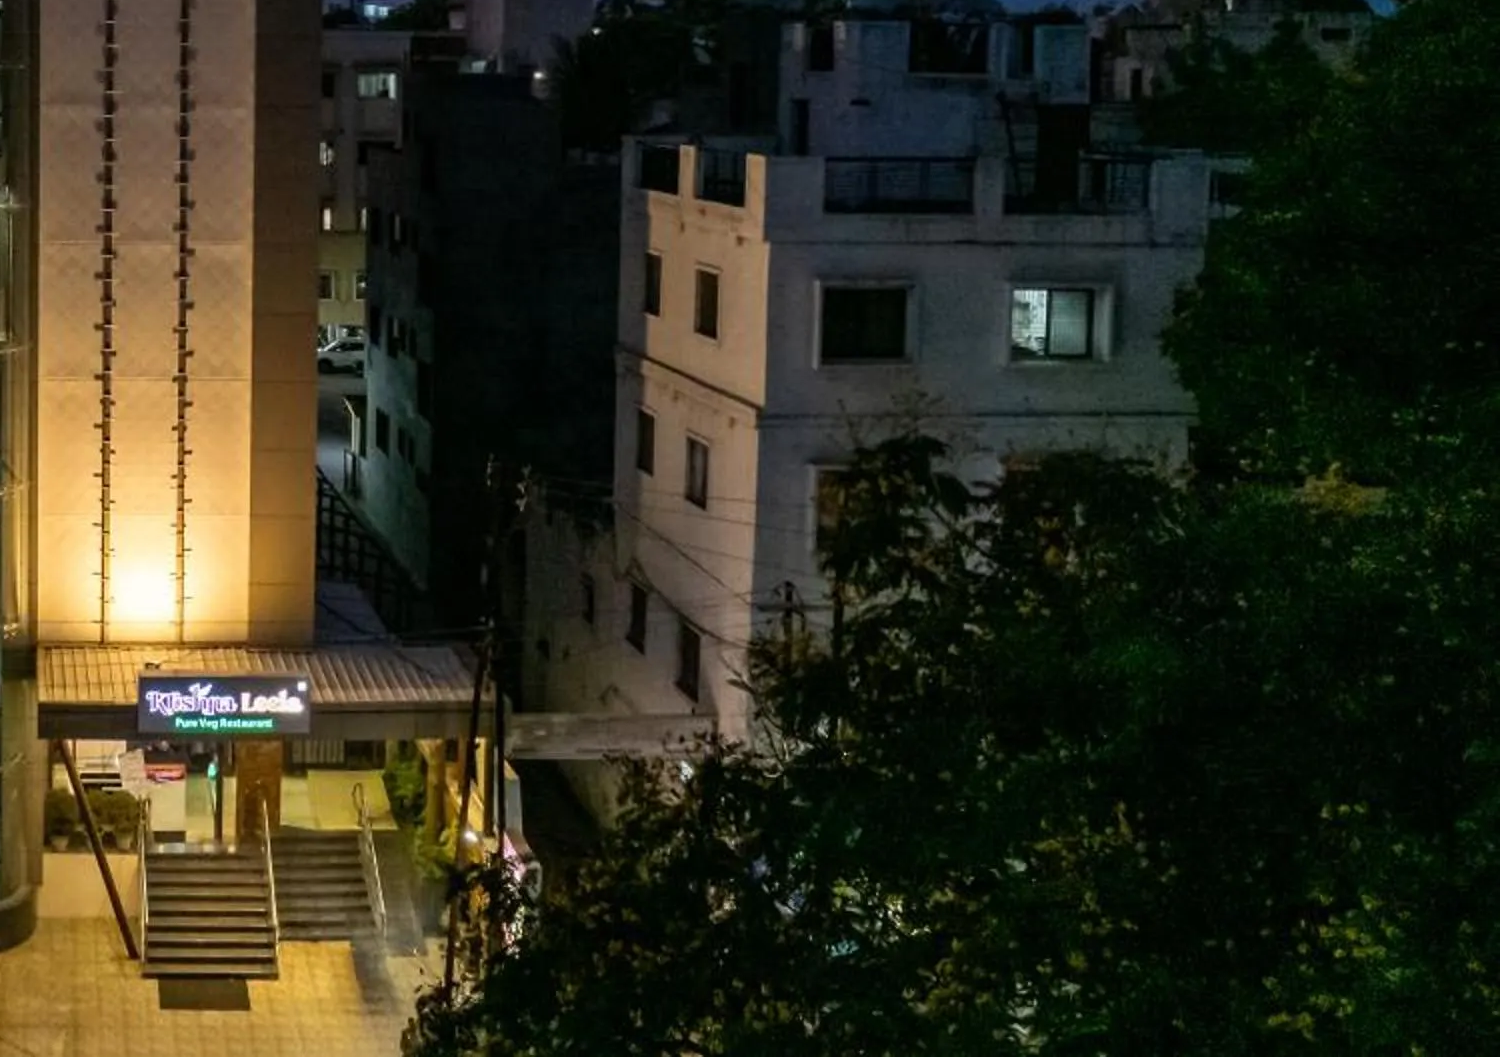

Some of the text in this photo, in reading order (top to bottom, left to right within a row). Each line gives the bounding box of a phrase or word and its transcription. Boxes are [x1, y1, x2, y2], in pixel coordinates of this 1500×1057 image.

[146, 683, 238, 716] Krishna
[175, 717, 198, 728] Pure
[199, 718, 218, 730] Veg
